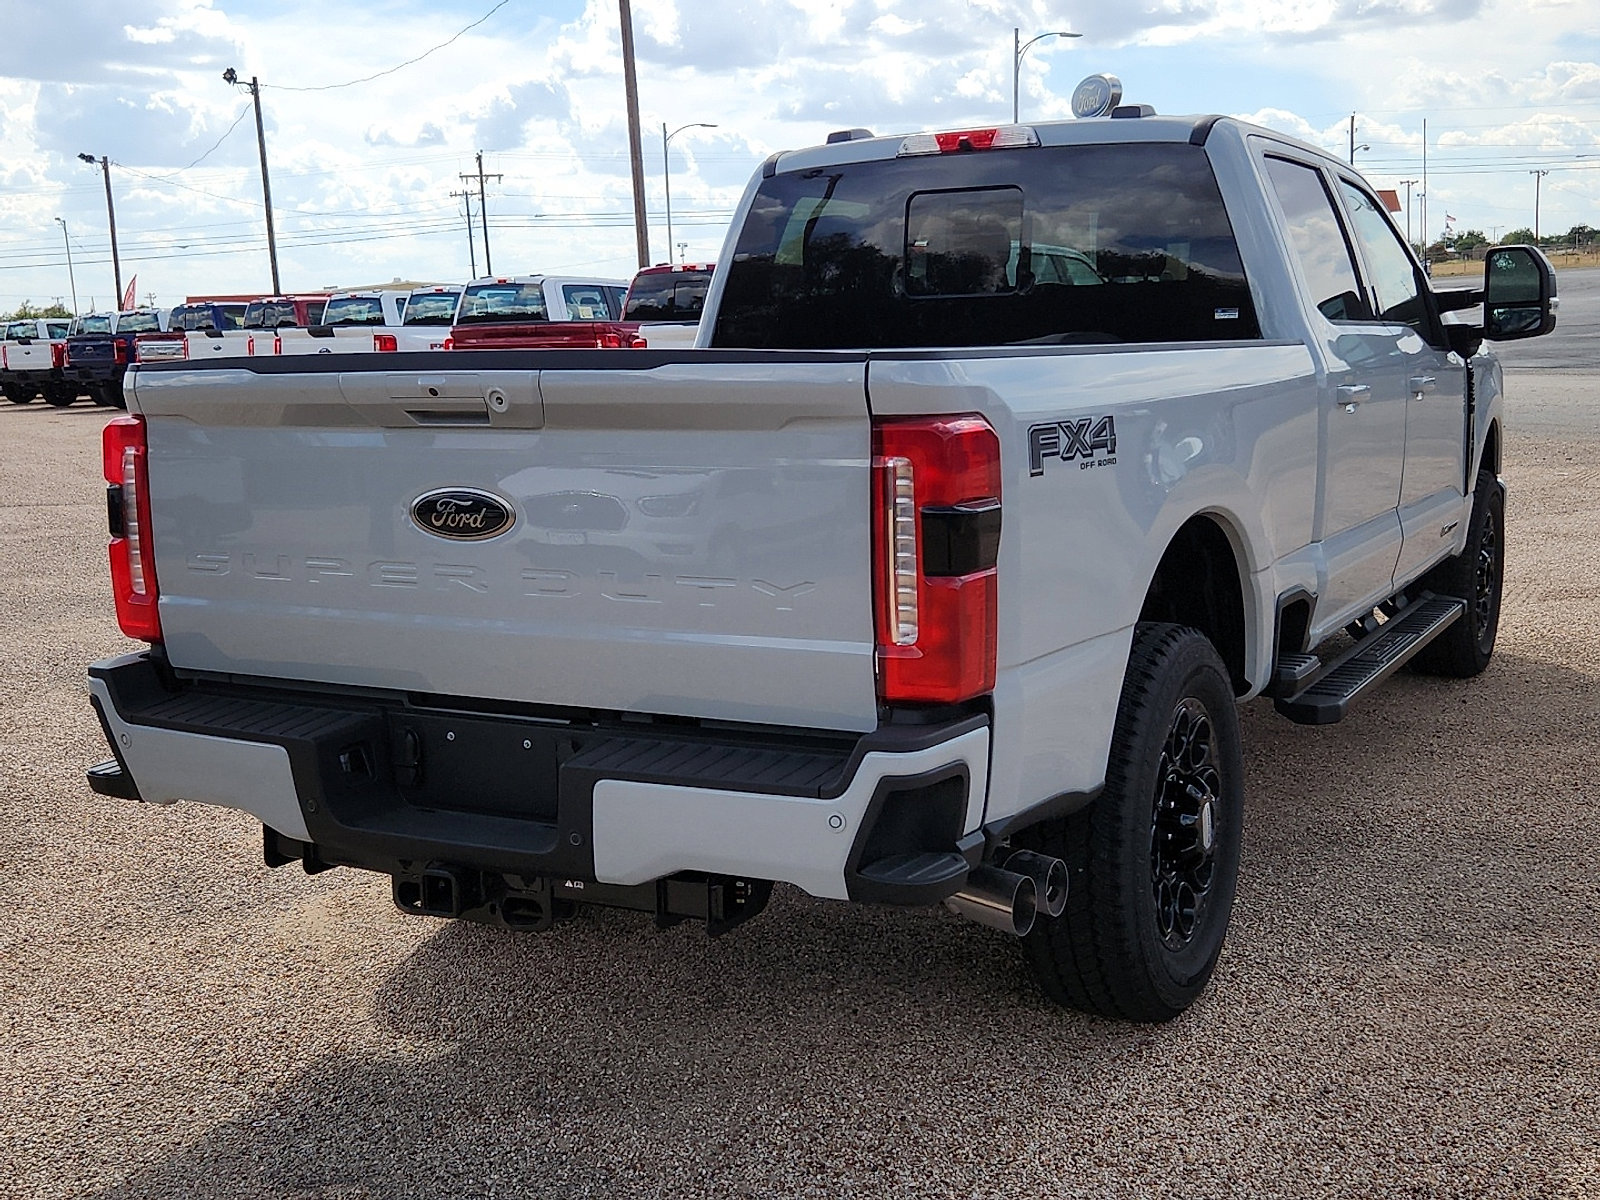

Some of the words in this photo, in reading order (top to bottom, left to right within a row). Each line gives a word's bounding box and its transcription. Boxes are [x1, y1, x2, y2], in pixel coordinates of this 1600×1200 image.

[1078, 84, 1101, 112] Ford
[1027, 415, 1117, 477] FX4
[1080, 460, 1096, 470] OFF
[1097, 457, 1117, 467] ROAD
[431, 498, 485, 528] Ford
[187, 552, 488, 593] SUPER
[520, 568, 817, 611] DUTY
